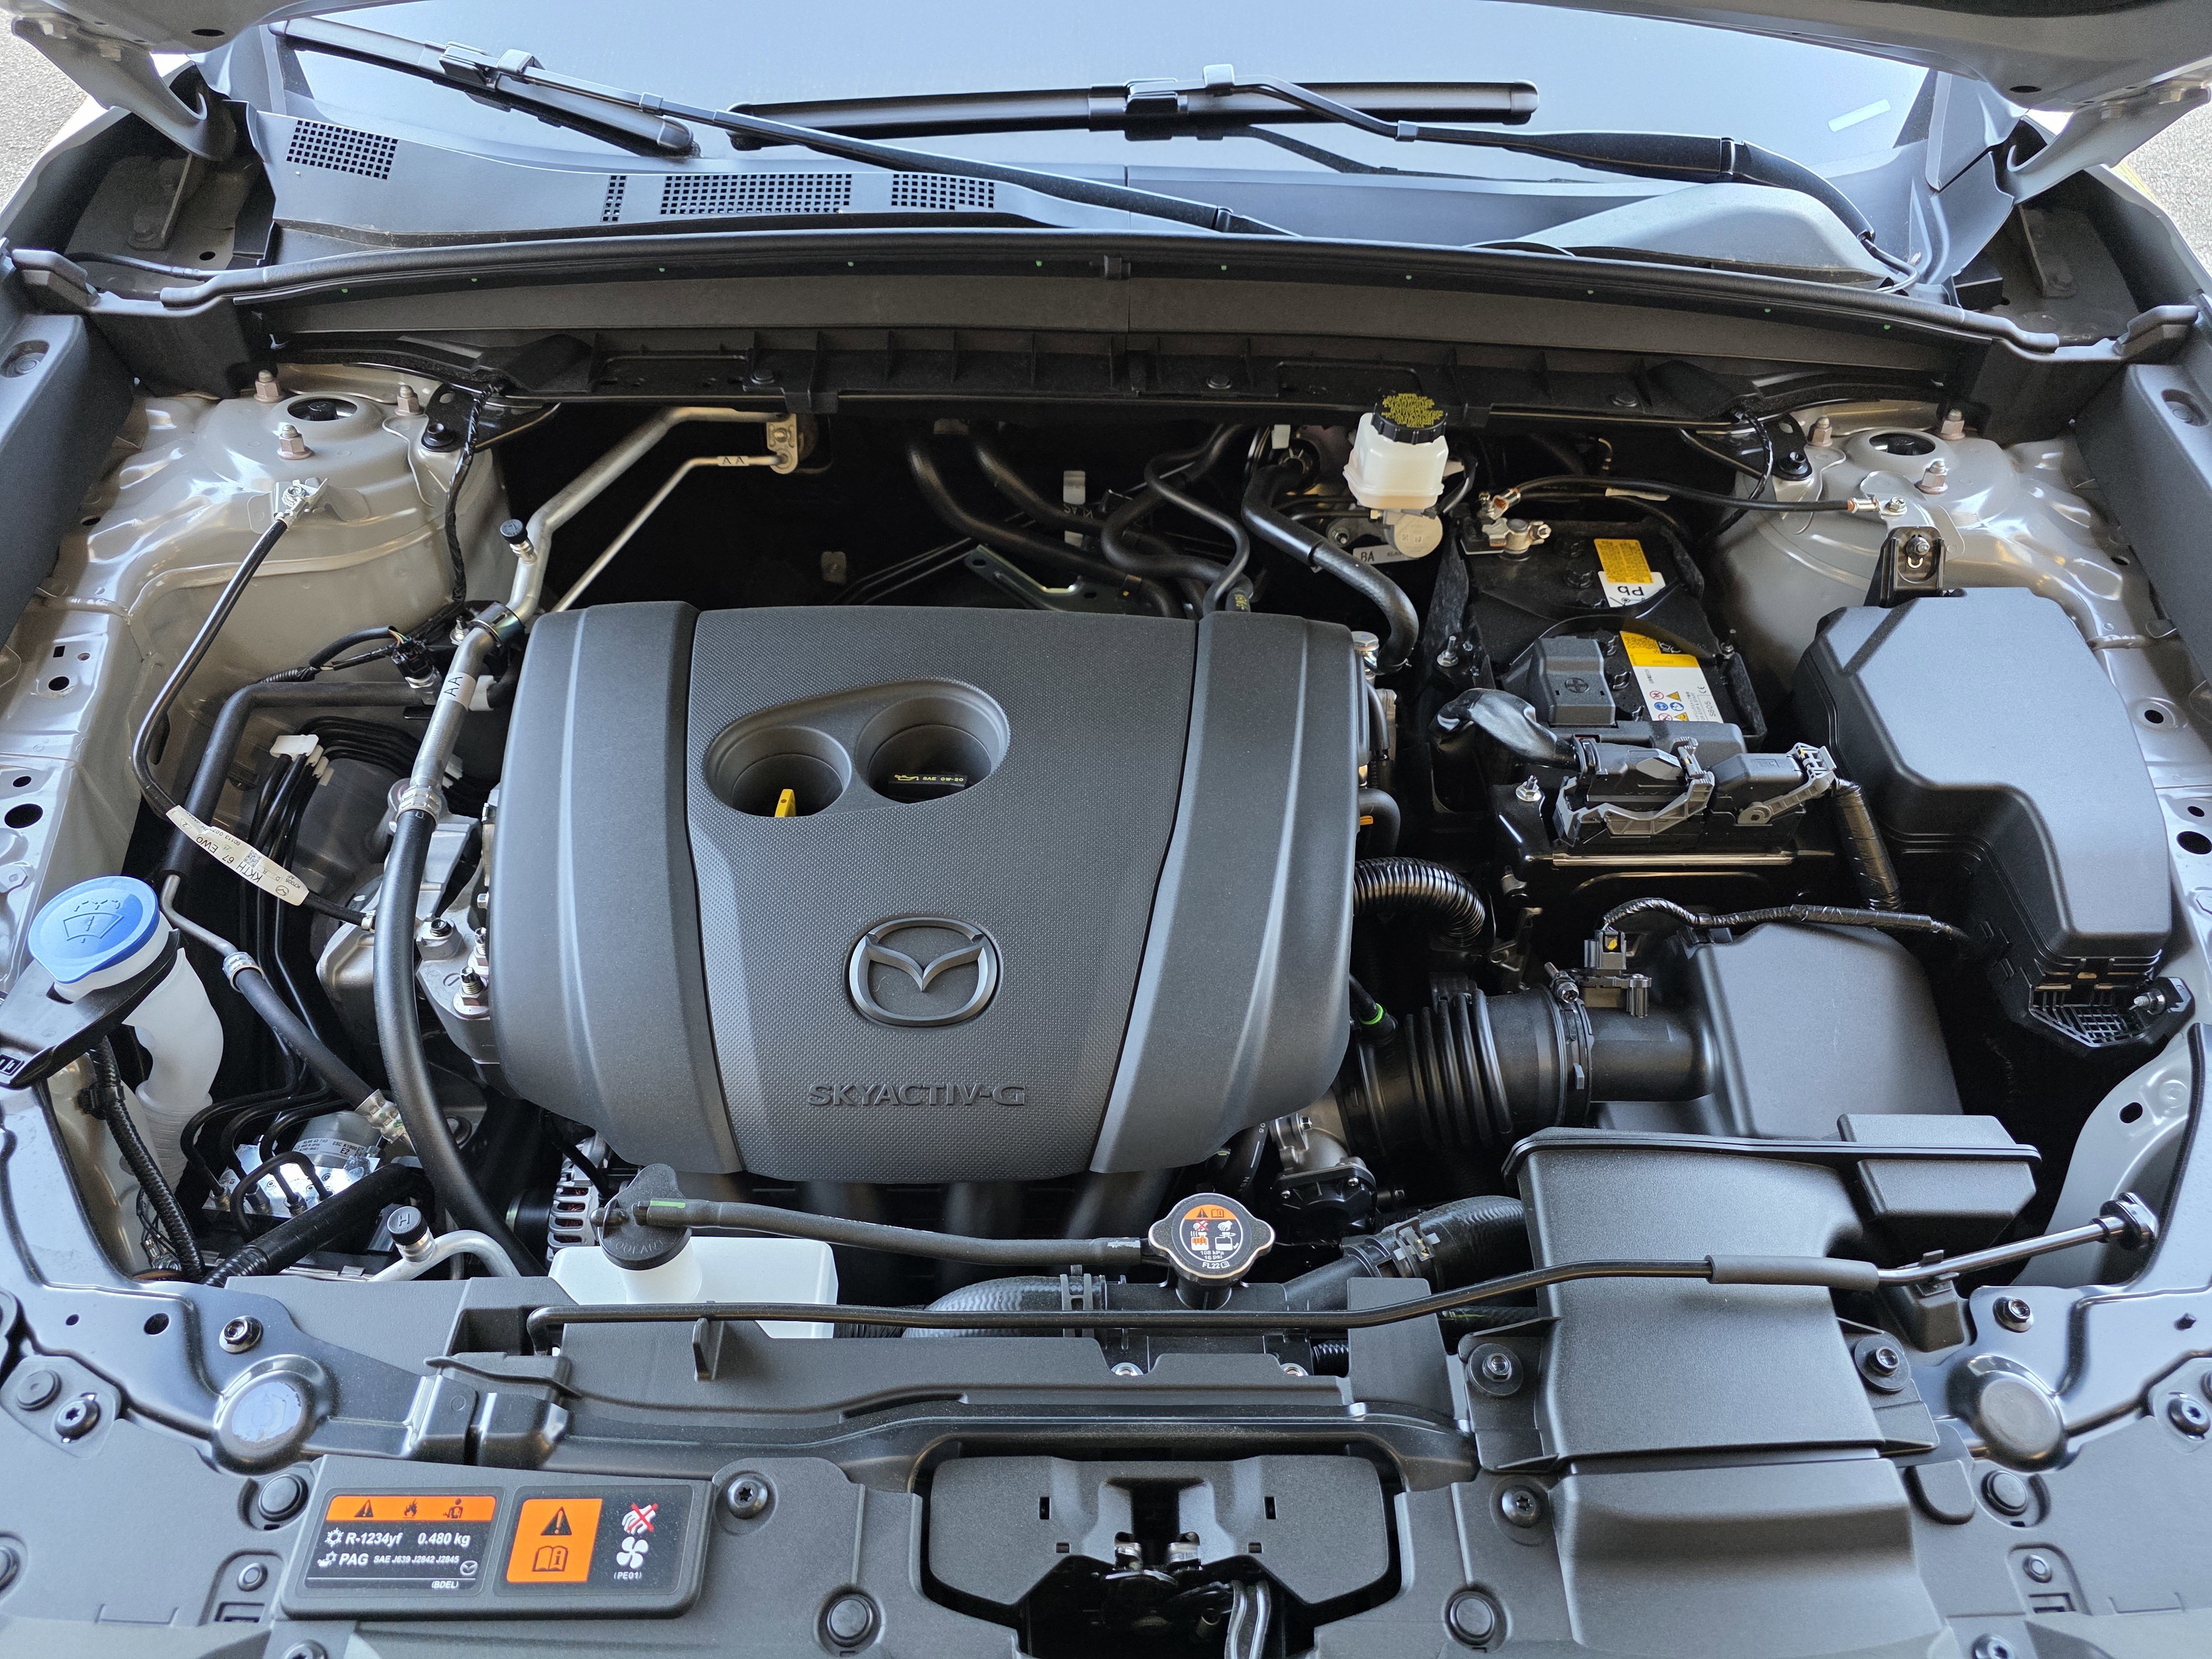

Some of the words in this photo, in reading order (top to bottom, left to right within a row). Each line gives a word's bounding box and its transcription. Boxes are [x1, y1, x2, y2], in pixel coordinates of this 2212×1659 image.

[1616, 585, 1645, 597] Pb
[443, 676, 463, 697] AA
[222, 854, 235, 865] 67
[236, 861, 264, 883] KKTH
[284, 877, 301, 889] K7005
[808, 1082, 1026, 1107] SKYACTIV-G
[345, 1532, 403, 1548] R-1234yf
[418, 1532, 452, 1545] 0.480
[453, 1532, 471, 1548] kg
[338, 1553, 369, 1566] PAG
[373, 1555, 390, 1563] SAE
[392, 1555, 411, 1564] J639
[411, 1555, 435, 1564] J2842
[436, 1555, 460, 1564] J2845
[613, 1571, 642, 1580] (PE01)
[431, 1580, 459, 1589] (BDEL)
